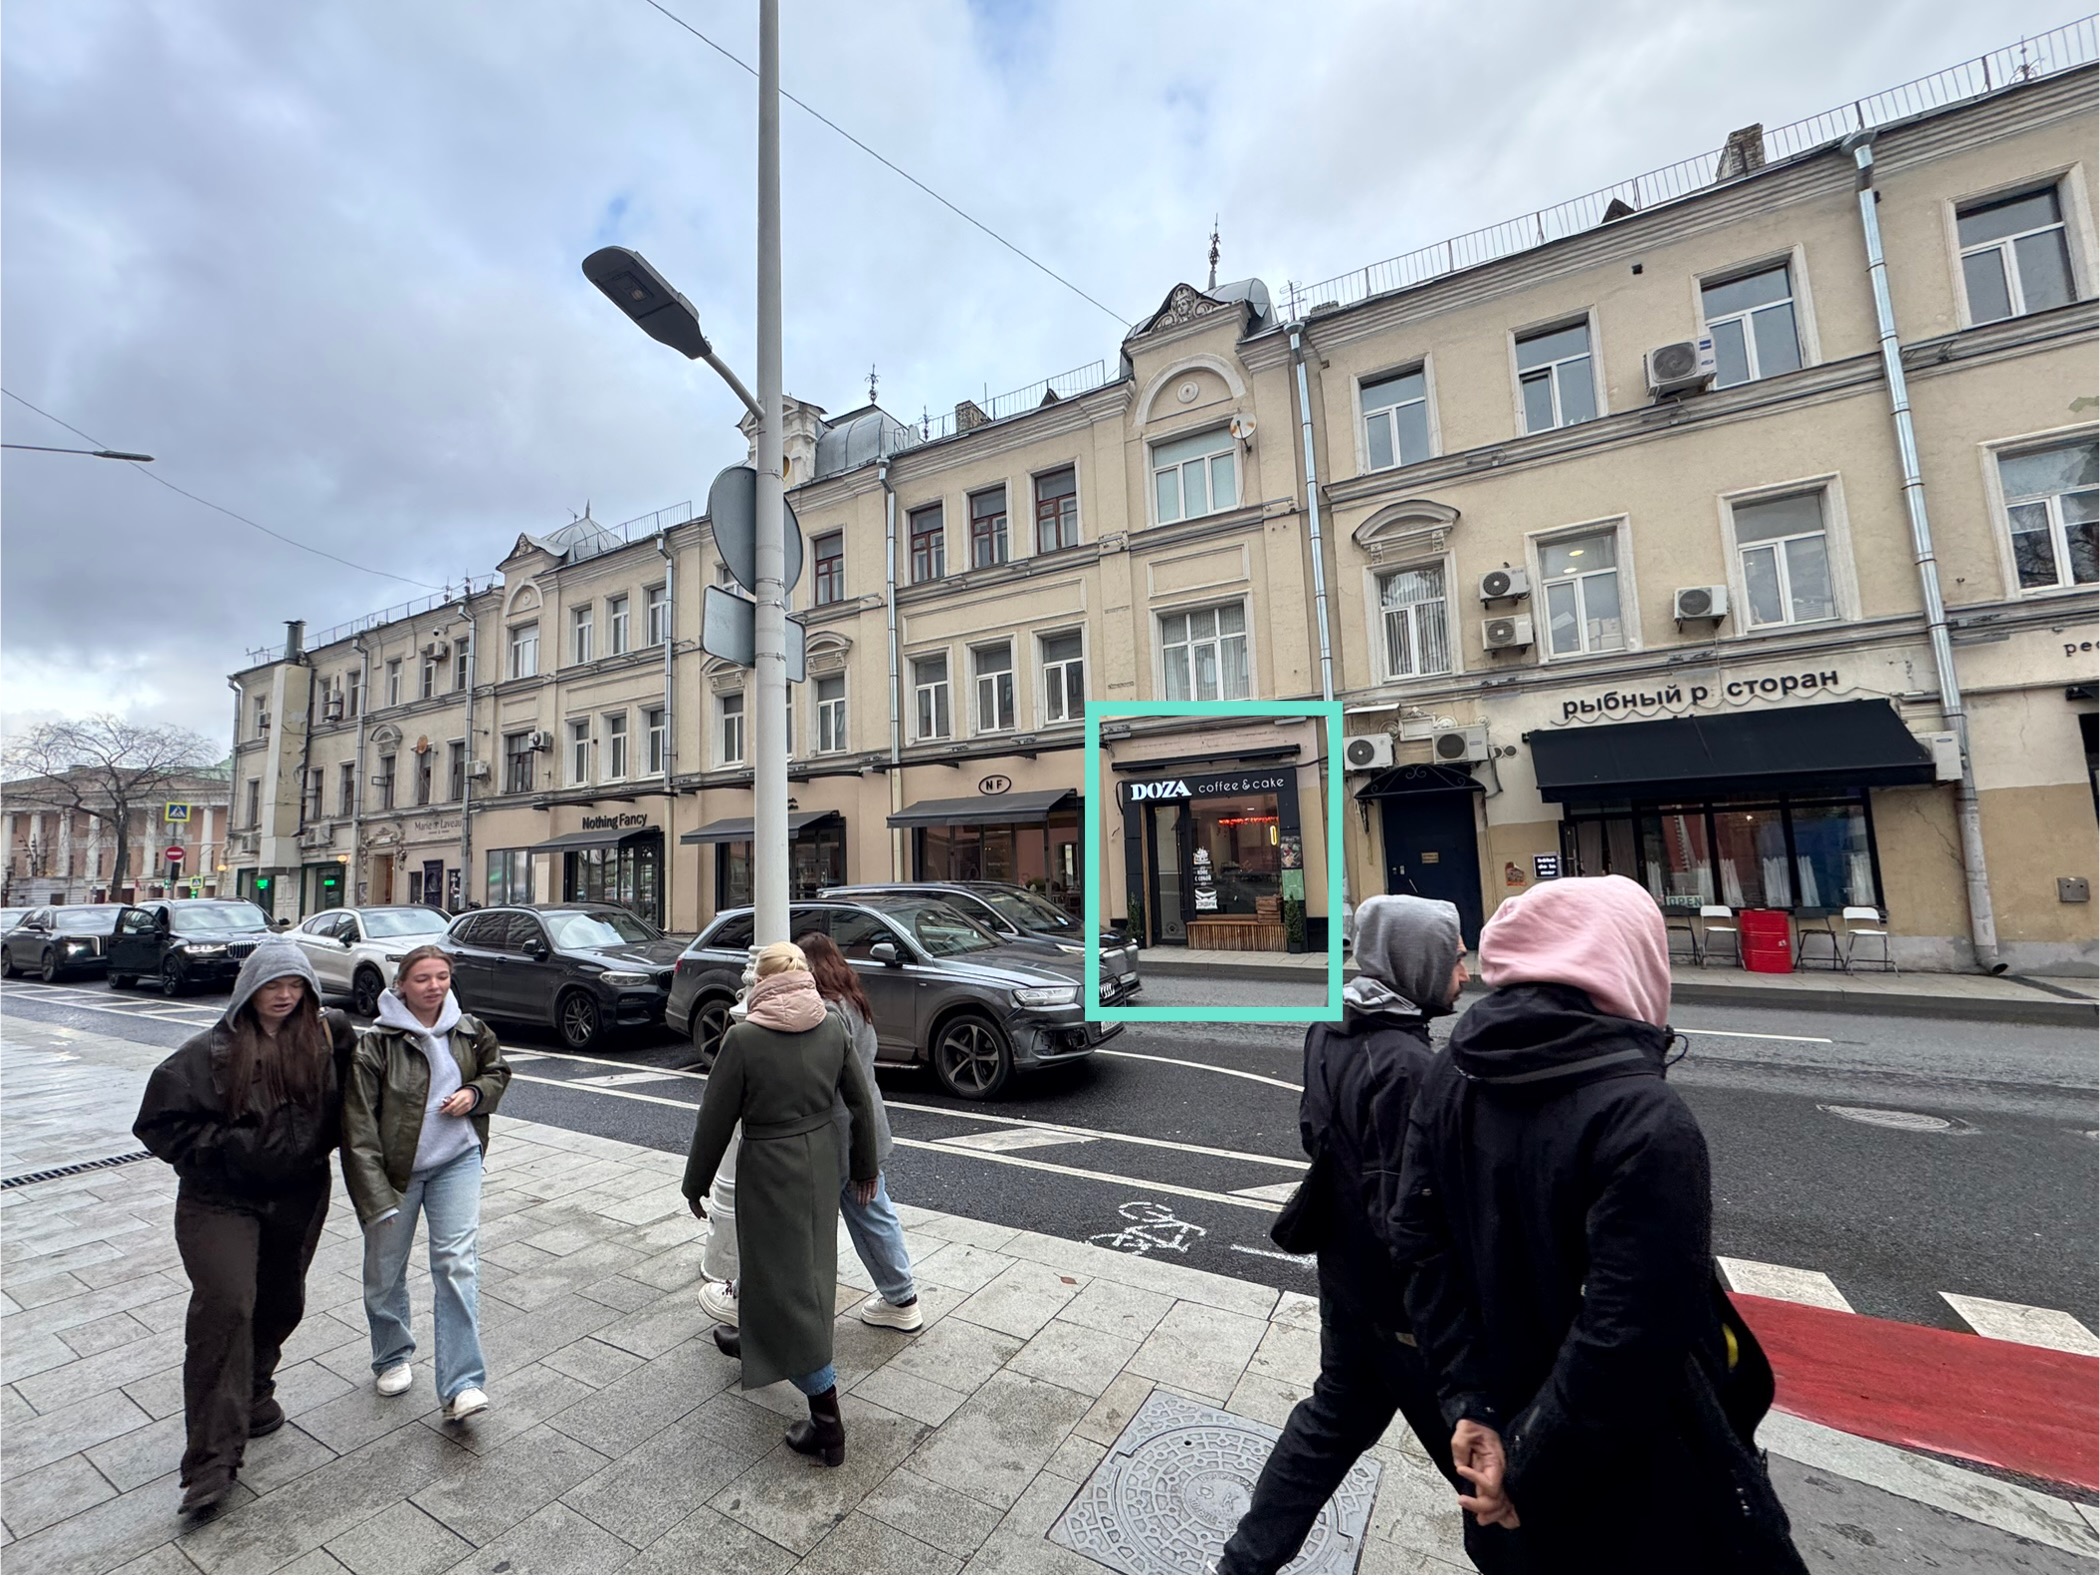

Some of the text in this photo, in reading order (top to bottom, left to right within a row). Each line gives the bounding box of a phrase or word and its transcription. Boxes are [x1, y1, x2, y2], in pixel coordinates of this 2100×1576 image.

[2063, 641, 2099, 657] ре
[1562, 683, 1682, 719] рыбный
[1130, 777, 1285, 801] DOZA coffee & cake
[582, 813, 648, 830] Nothing Fancy
[1668, 896, 1702, 907] OPEN
